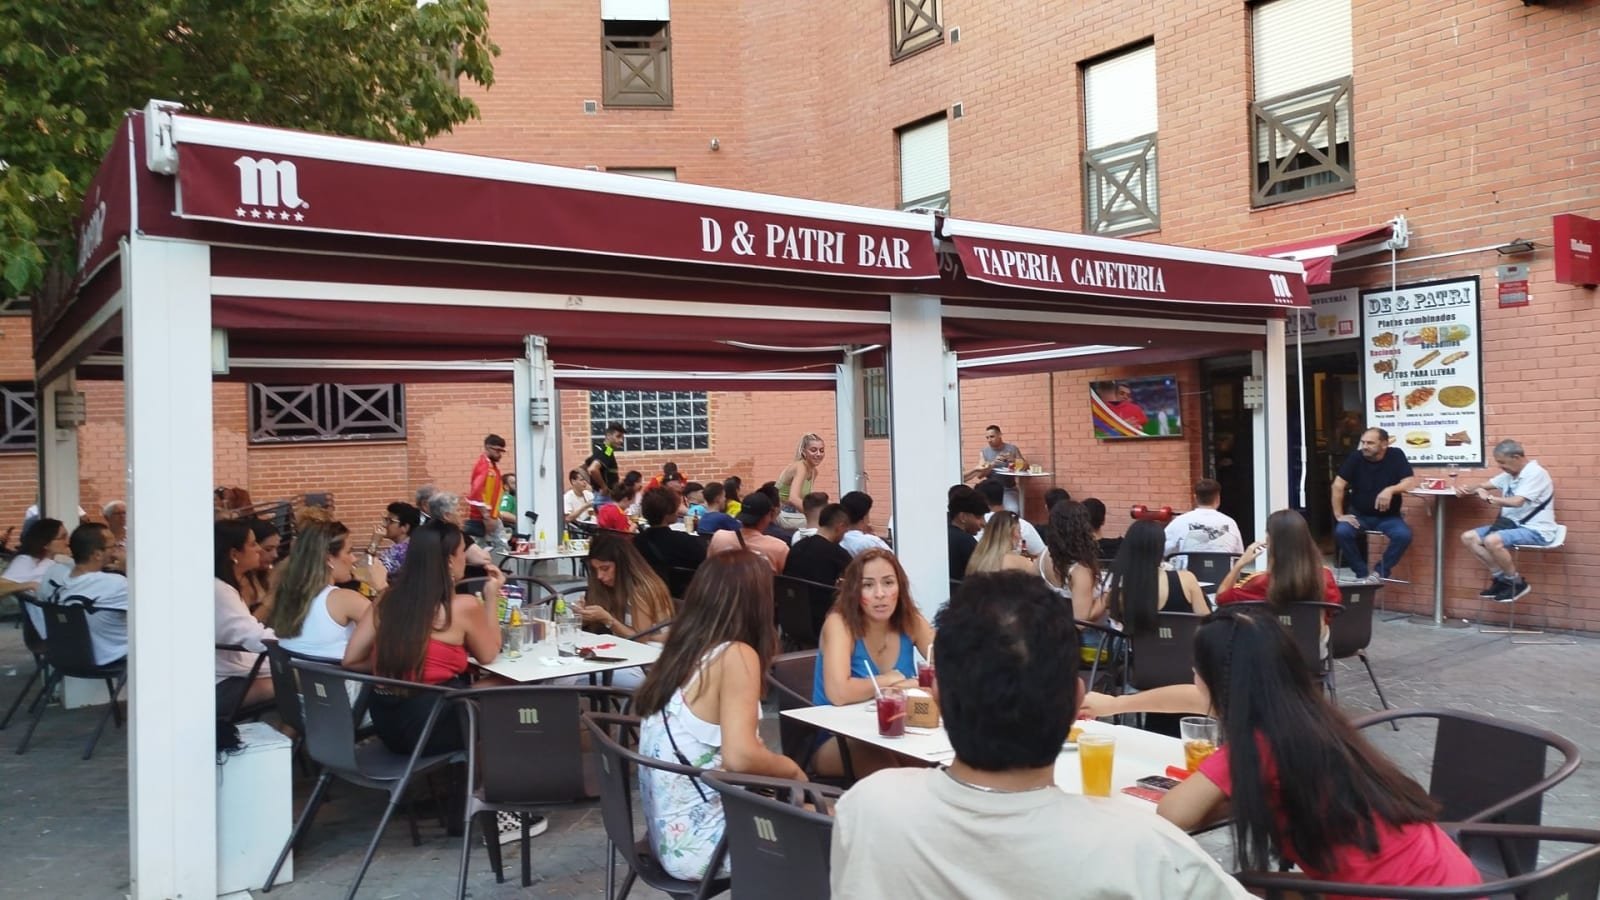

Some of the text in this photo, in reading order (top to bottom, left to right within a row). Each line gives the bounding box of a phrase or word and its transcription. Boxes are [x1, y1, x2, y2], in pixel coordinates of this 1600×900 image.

[233, 156, 304, 209] m
[700, 217, 722, 252] D
[731, 220, 756, 256] &
[765, 223, 845, 265] PATRI
[857, 234, 912, 269] BAR
[973, 247, 1064, 283] TAPERIA
[1071, 257, 1166, 293] CAFETERIA
[1368, 288, 1471, 314] DE & PATRI
[1378, 313, 1456, 328] Platos combinados
[1410, 370, 1429, 378] PARA
[1430, 368, 1456, 376] LLEVAR
